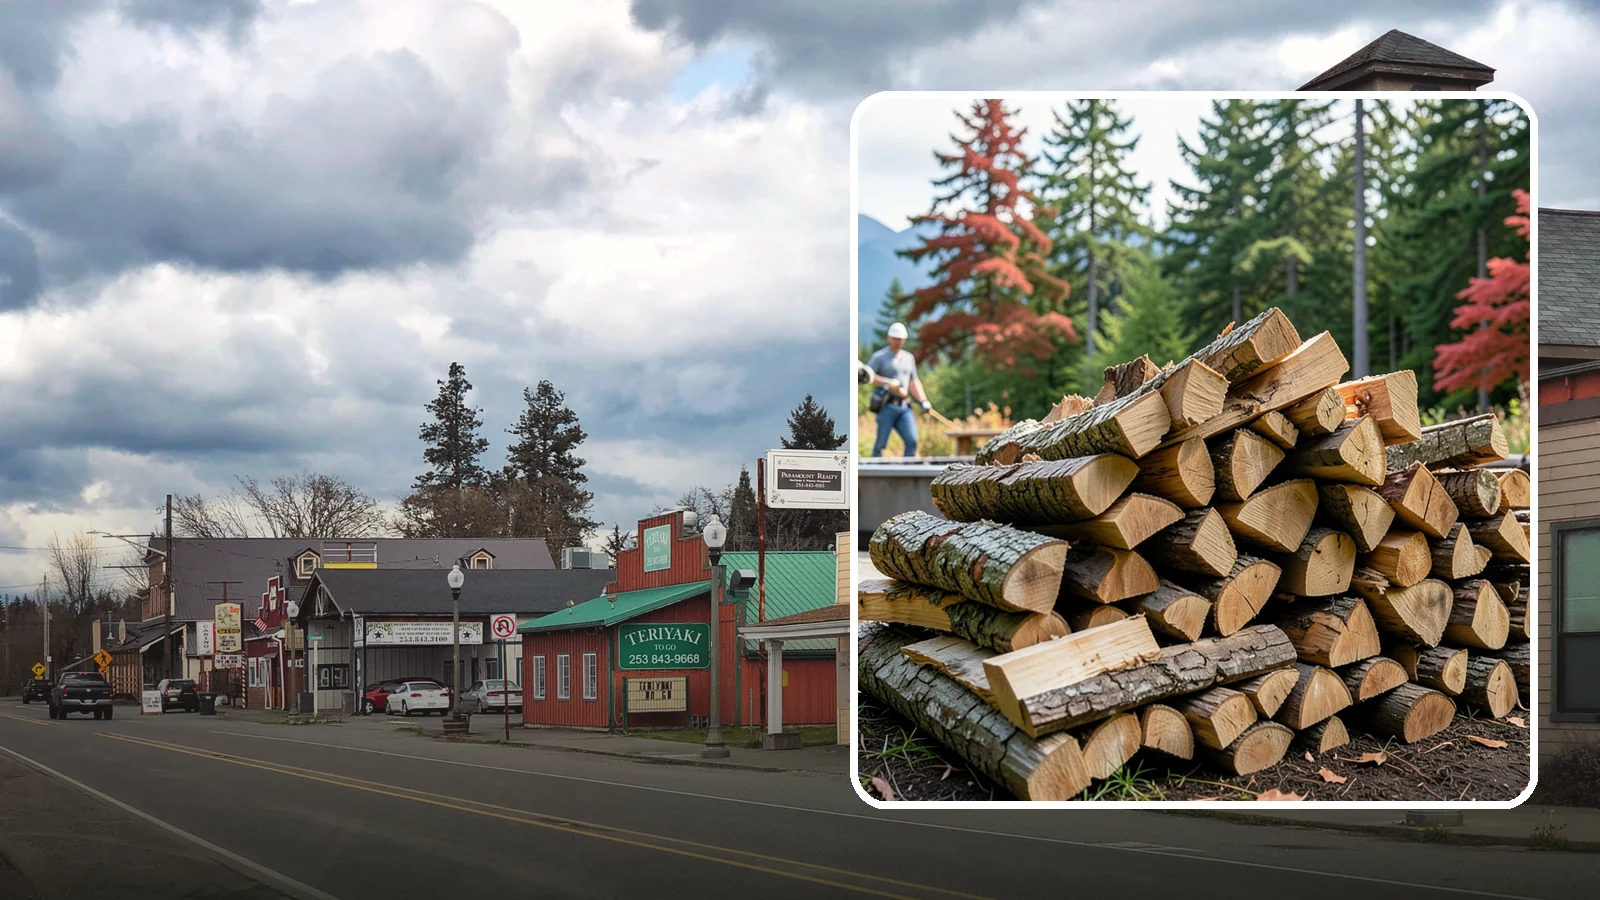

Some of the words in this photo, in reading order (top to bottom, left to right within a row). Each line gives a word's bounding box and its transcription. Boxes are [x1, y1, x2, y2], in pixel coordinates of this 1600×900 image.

[781, 471, 814, 479] PARAMOUNT
[817, 472, 839, 480] REALTY
[624, 627, 702, 646] TERIYAKI
[629, 654, 648, 664] 253
[652, 654, 700, 664] 843-9668
[639, 681, 672, 691] TERIYAKI
